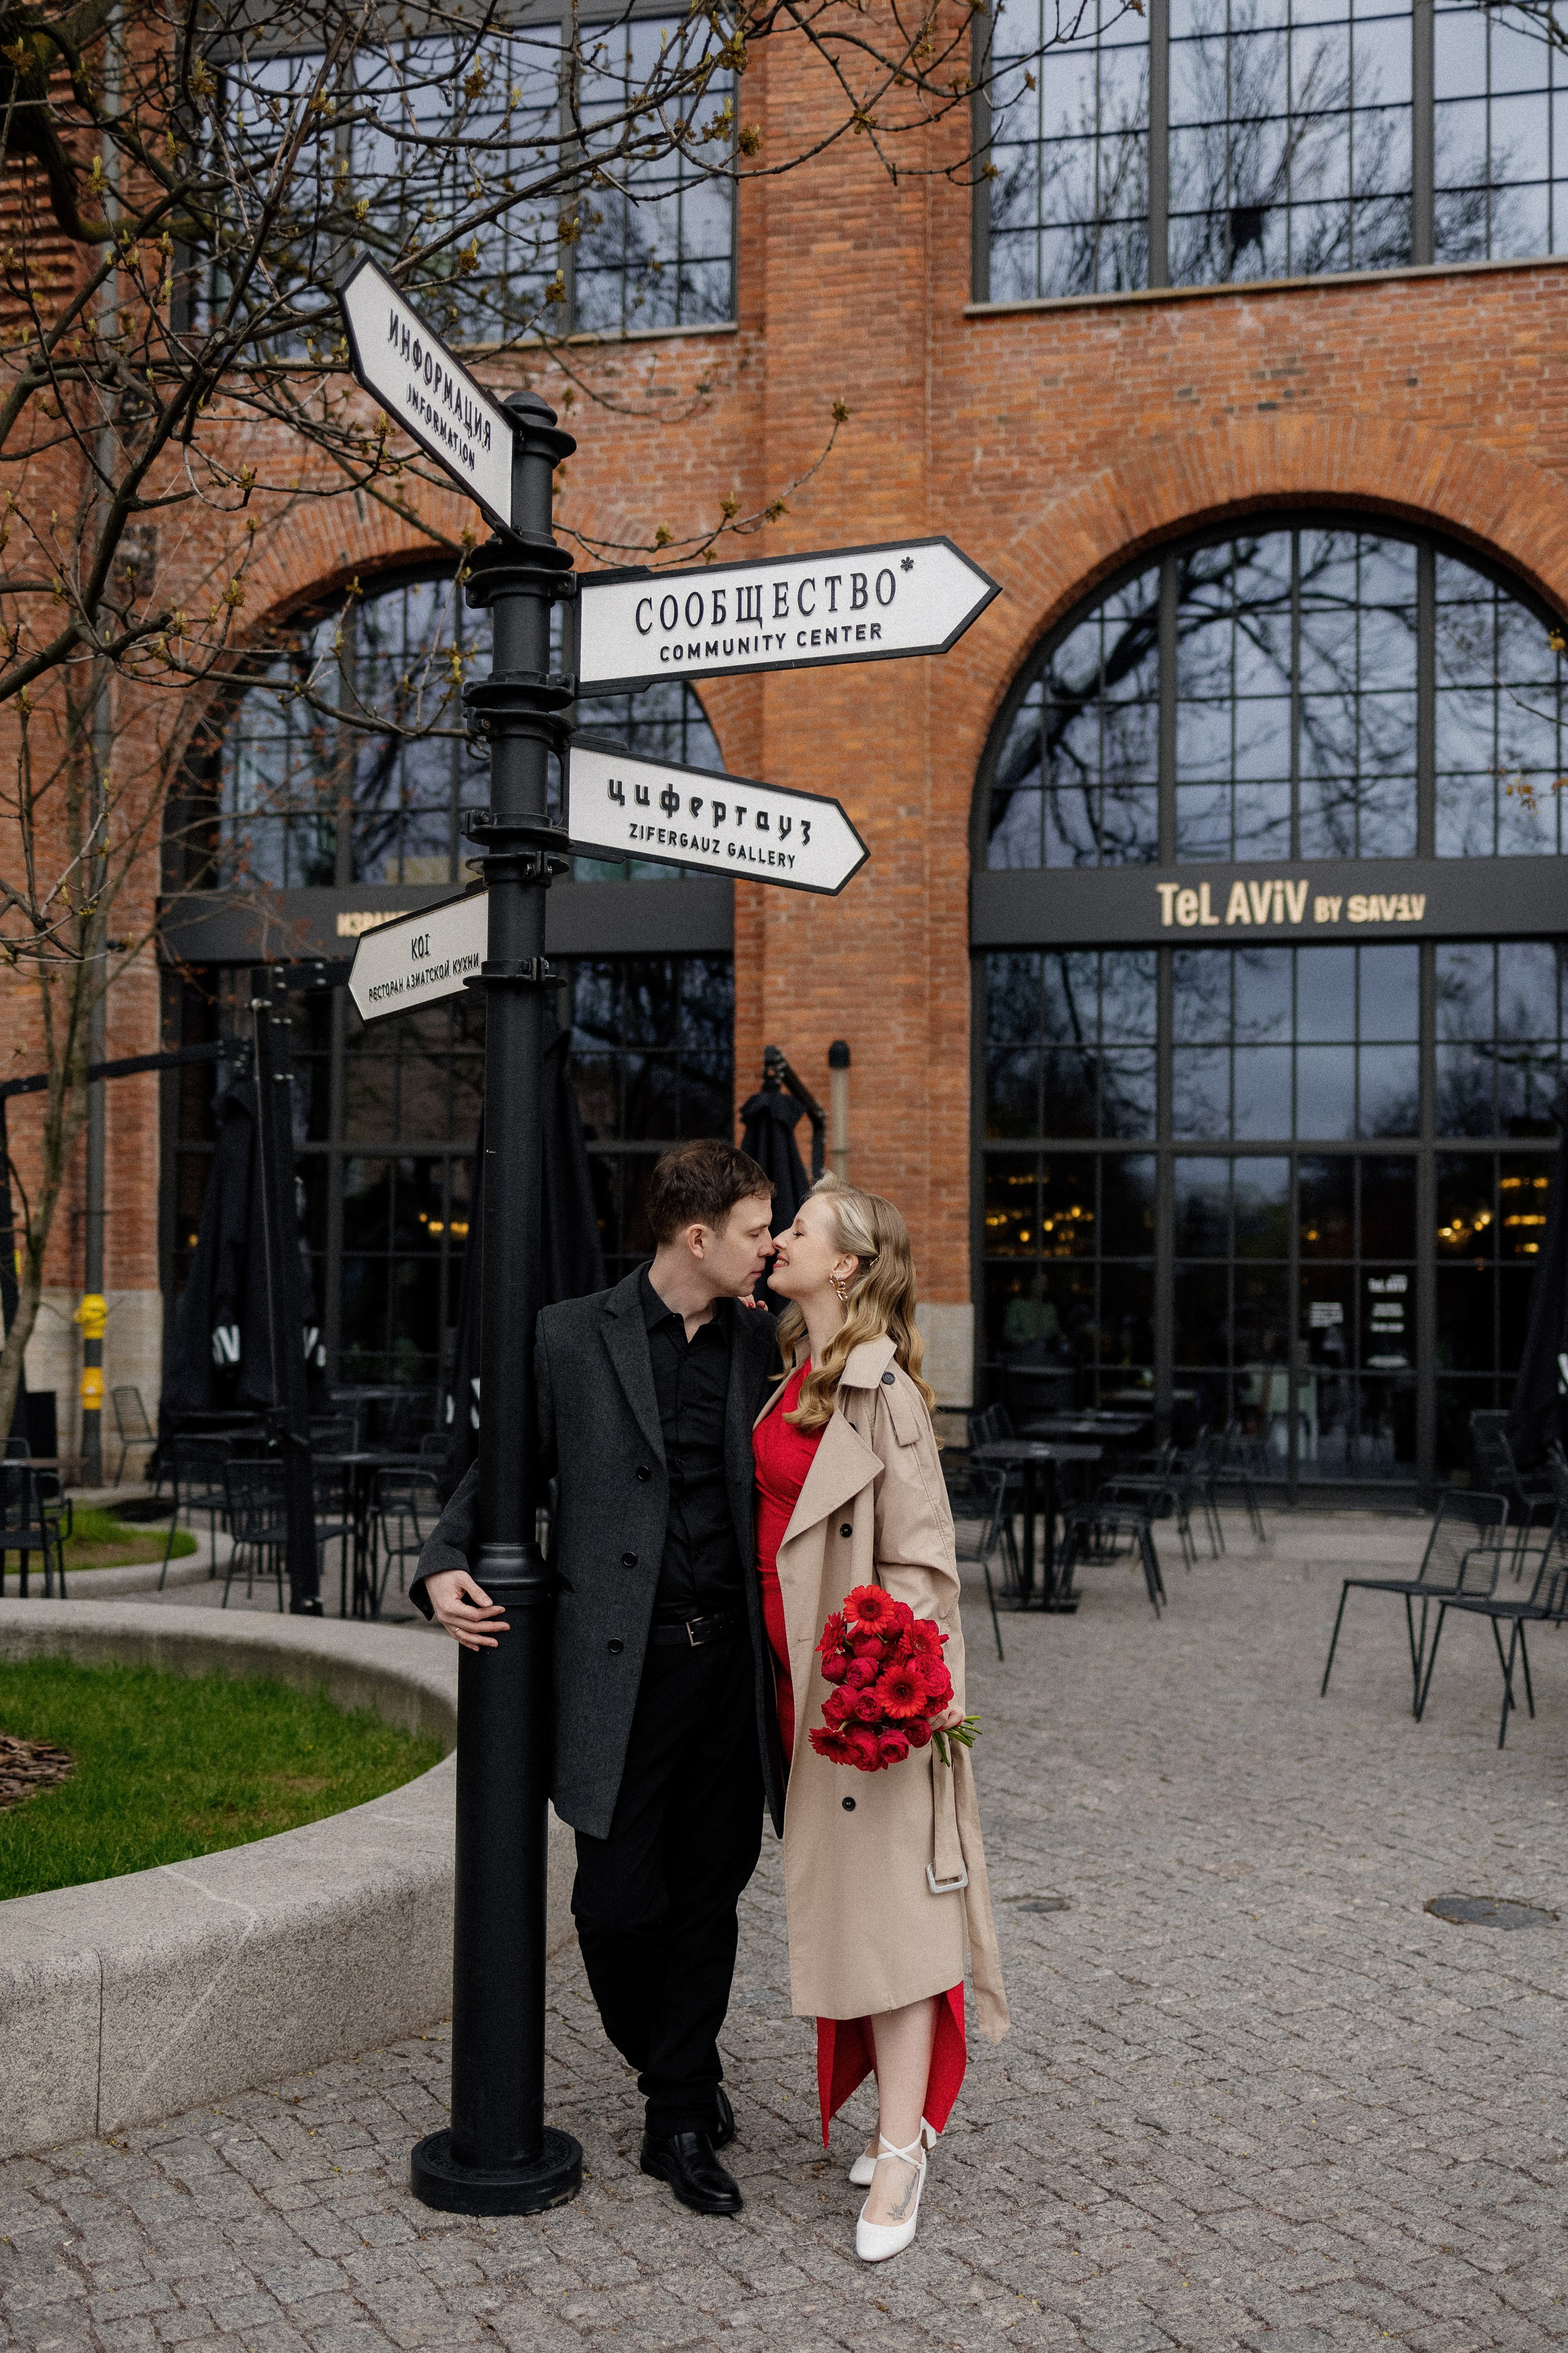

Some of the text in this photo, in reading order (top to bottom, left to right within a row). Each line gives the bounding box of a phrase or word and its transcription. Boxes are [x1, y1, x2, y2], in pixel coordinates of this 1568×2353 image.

[388, 308, 491, 452] ИНФОРМАЦИЯ
[407, 382, 475, 471] INFORMATION
[660, 622, 883, 662] COMMUNITY CENTER
[628, 822, 796, 869] ZIFERGAUZ GALLERY
[1314, 894, 1343, 923] BY
[369, 952, 480, 1002] РЕСТОРАН АЗИАТСКОЙ КУХНИ
